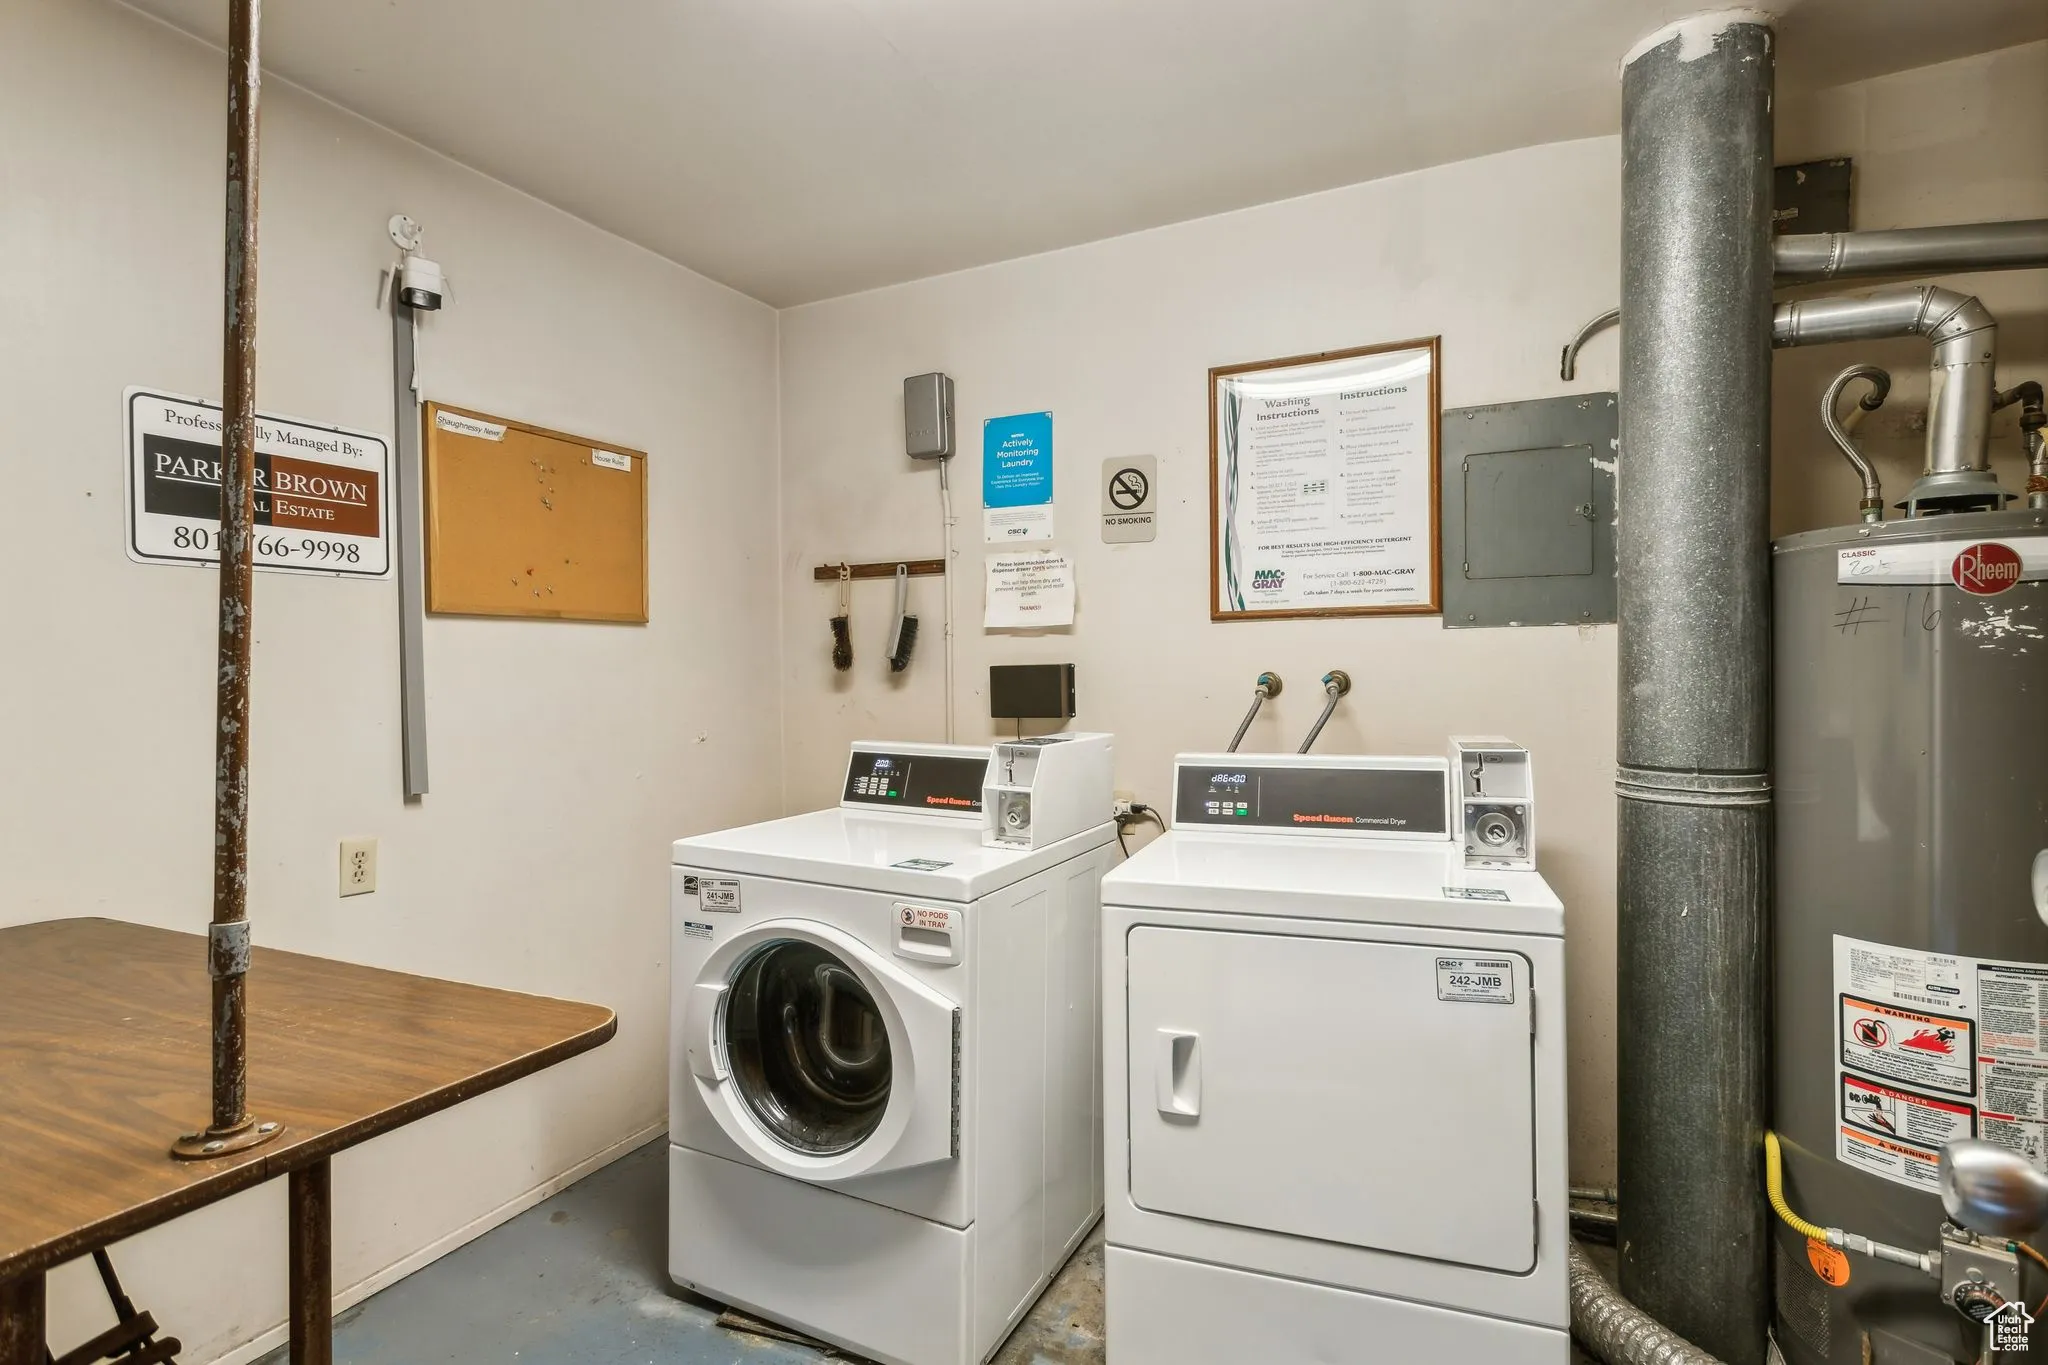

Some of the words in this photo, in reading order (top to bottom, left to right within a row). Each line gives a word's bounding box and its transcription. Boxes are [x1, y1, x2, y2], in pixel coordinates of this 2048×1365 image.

[1339, 385, 1408, 400] Instructions
[1265, 397, 1311, 409] Washing
[1256, 407, 1320, 421] Instructions
[437, 416, 483, 434] Shaughnessy
[164, 408, 272, 443] Professlly
[276, 429, 338, 453] Managed
[343, 443, 364, 458] By:
[1002, 438, 1034, 448] Actively
[595, 455, 611, 463] House
[996, 448, 1039, 459] Monitoring
[1001, 459, 1034, 468] Laundry
[154, 453, 268, 489] PARKR
[275, 471, 368, 502] BROWN
[1118, 516, 1152, 525] SMOKING
[173, 526, 360, 563] 80166-9998
[1323, 538, 1374, 546] HIGH-EFFICIENCY
[1841, 549, 1877, 559] CLASSIC
[1959, 545, 2018, 587] Rheem
[1352, 568, 1415, 577] 1-800-MAC-GRAY
[1252, 579, 1285, 589] GRAY
[927, 796, 948, 804] Speed
[949, 797, 971, 805] Queen
[1293, 813, 1322, 823] Speed
[1323, 814, 1353, 824] Queen
[1355, 816, 1389, 825] Commercial
[1390, 817, 1407, 826] Dryer
[706, 891, 735, 900] 241-JMB
[917, 910, 927, 918] NO
[928, 911, 949, 920] PODS
[927, 920, 946, 928] TRAY
[1449, 975, 1502, 986] 242-JMB
[1884, 1008, 1931, 1023] WARNING
[1889, 1091, 1928, 1106] DANGER
[1889, 1144, 1932, 1161] WARNING
